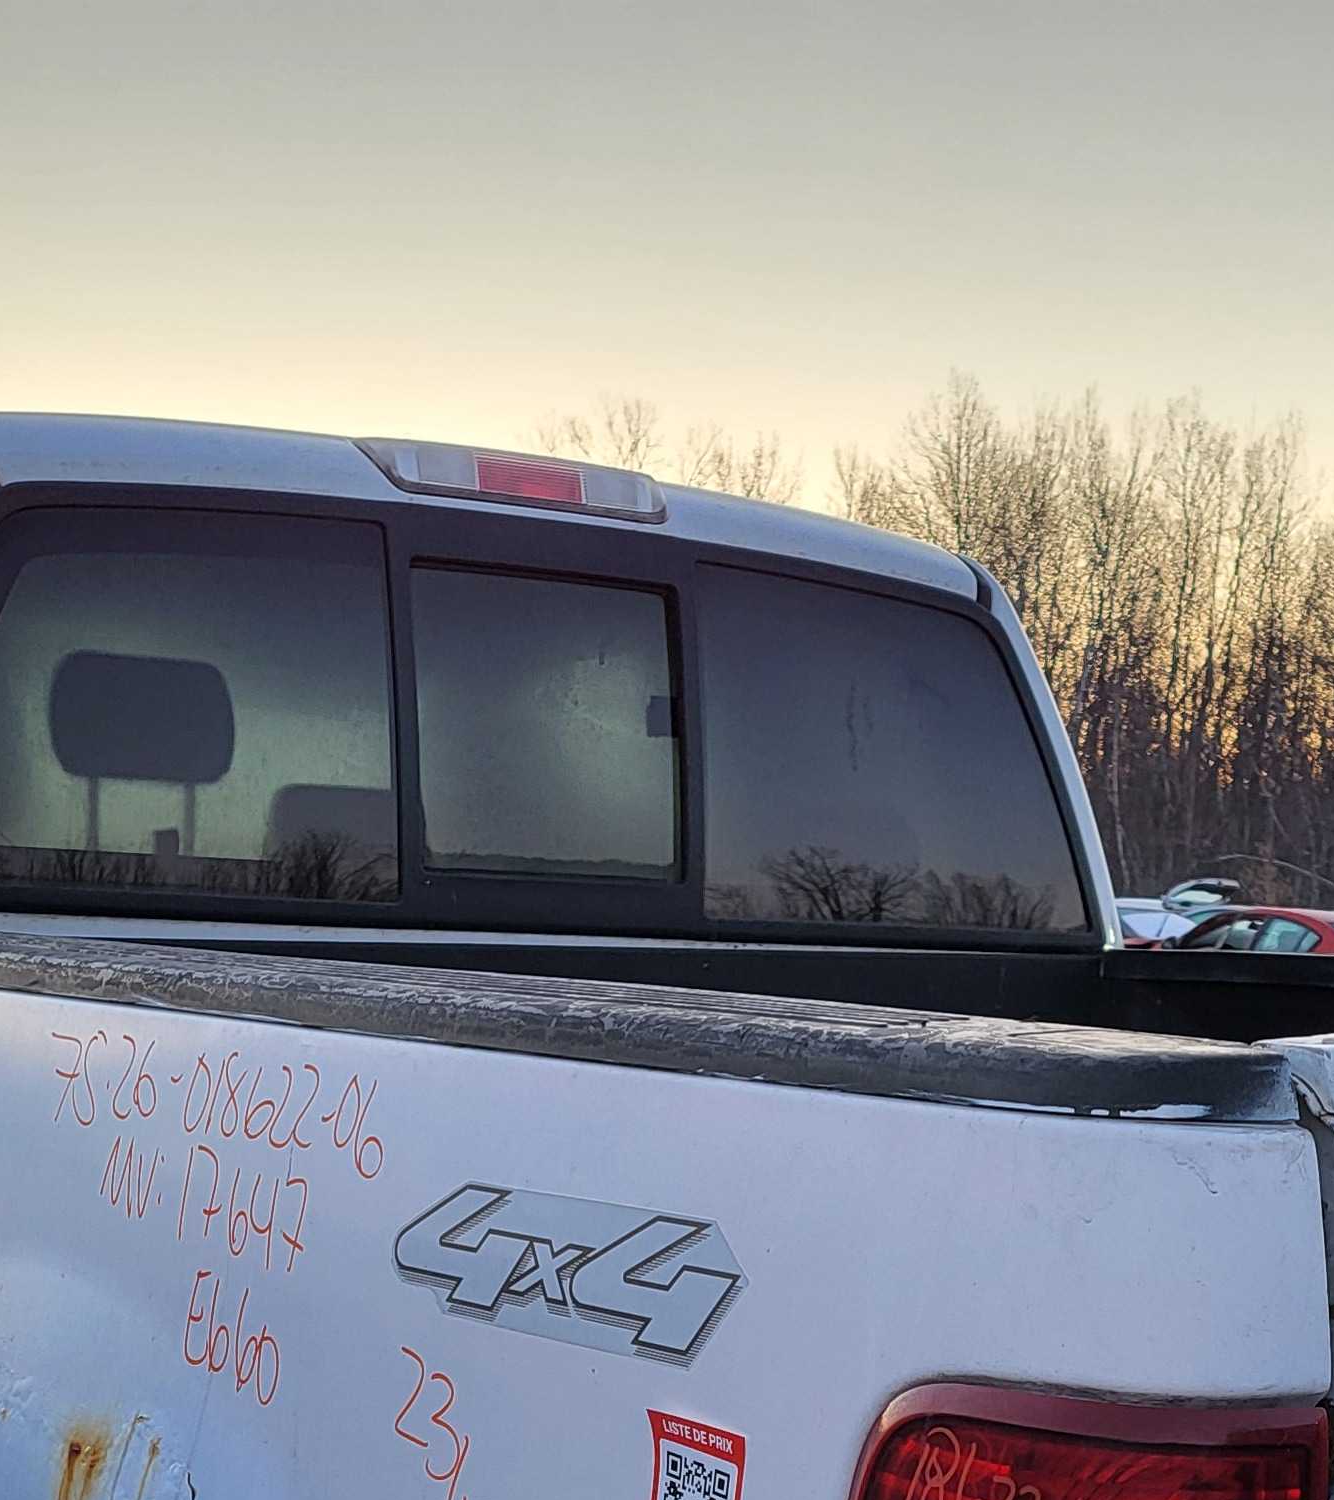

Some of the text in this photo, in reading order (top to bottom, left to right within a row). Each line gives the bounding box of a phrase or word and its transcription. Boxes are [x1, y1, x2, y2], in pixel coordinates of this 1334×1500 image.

[177, 1144, 308, 1273] 17647
[394, 1183, 745, 1368] 4x4
[662, 1418, 734, 1455] LISTE DE PRIX
